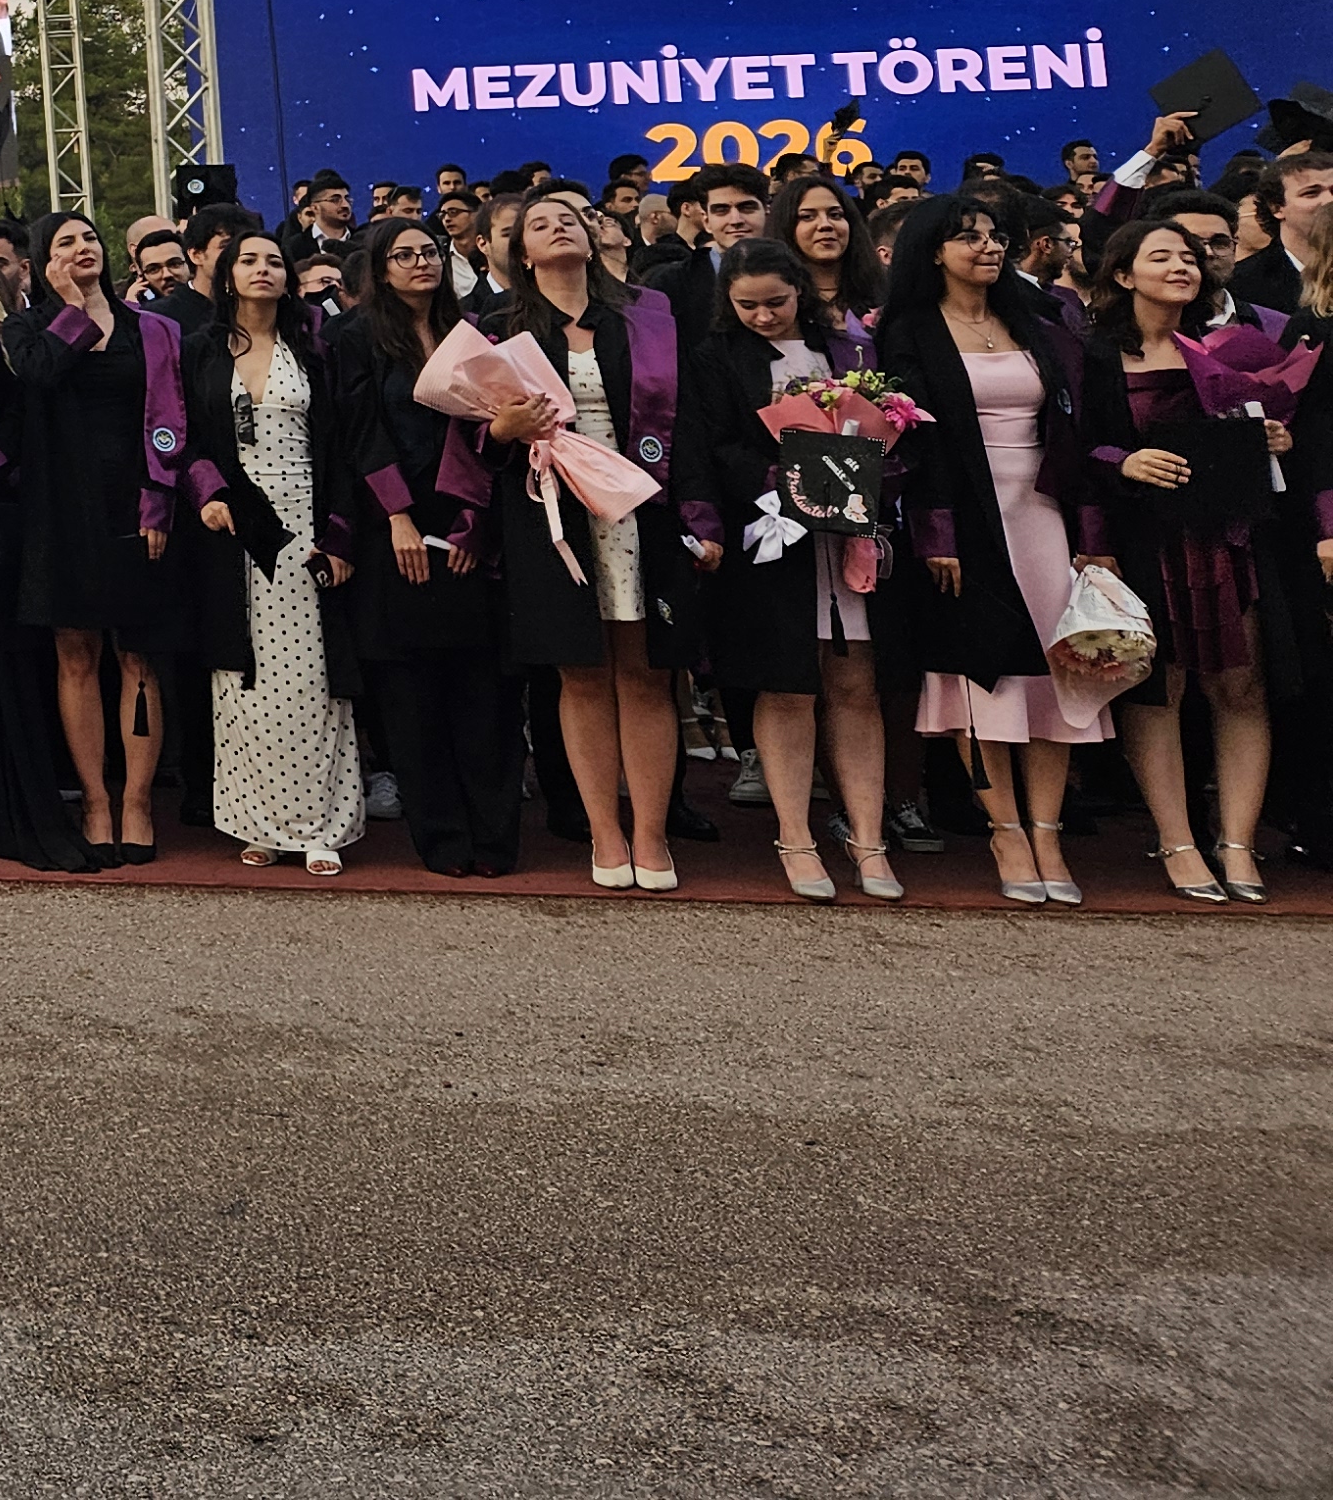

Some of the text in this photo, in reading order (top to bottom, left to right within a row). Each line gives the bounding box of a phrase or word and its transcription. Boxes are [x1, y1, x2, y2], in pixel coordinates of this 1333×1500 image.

[412, 27, 1109, 112] MEZUNİYET TÖRENİ
[645, 118, 873, 182] 2026
[843, 457, 860, 473] git
